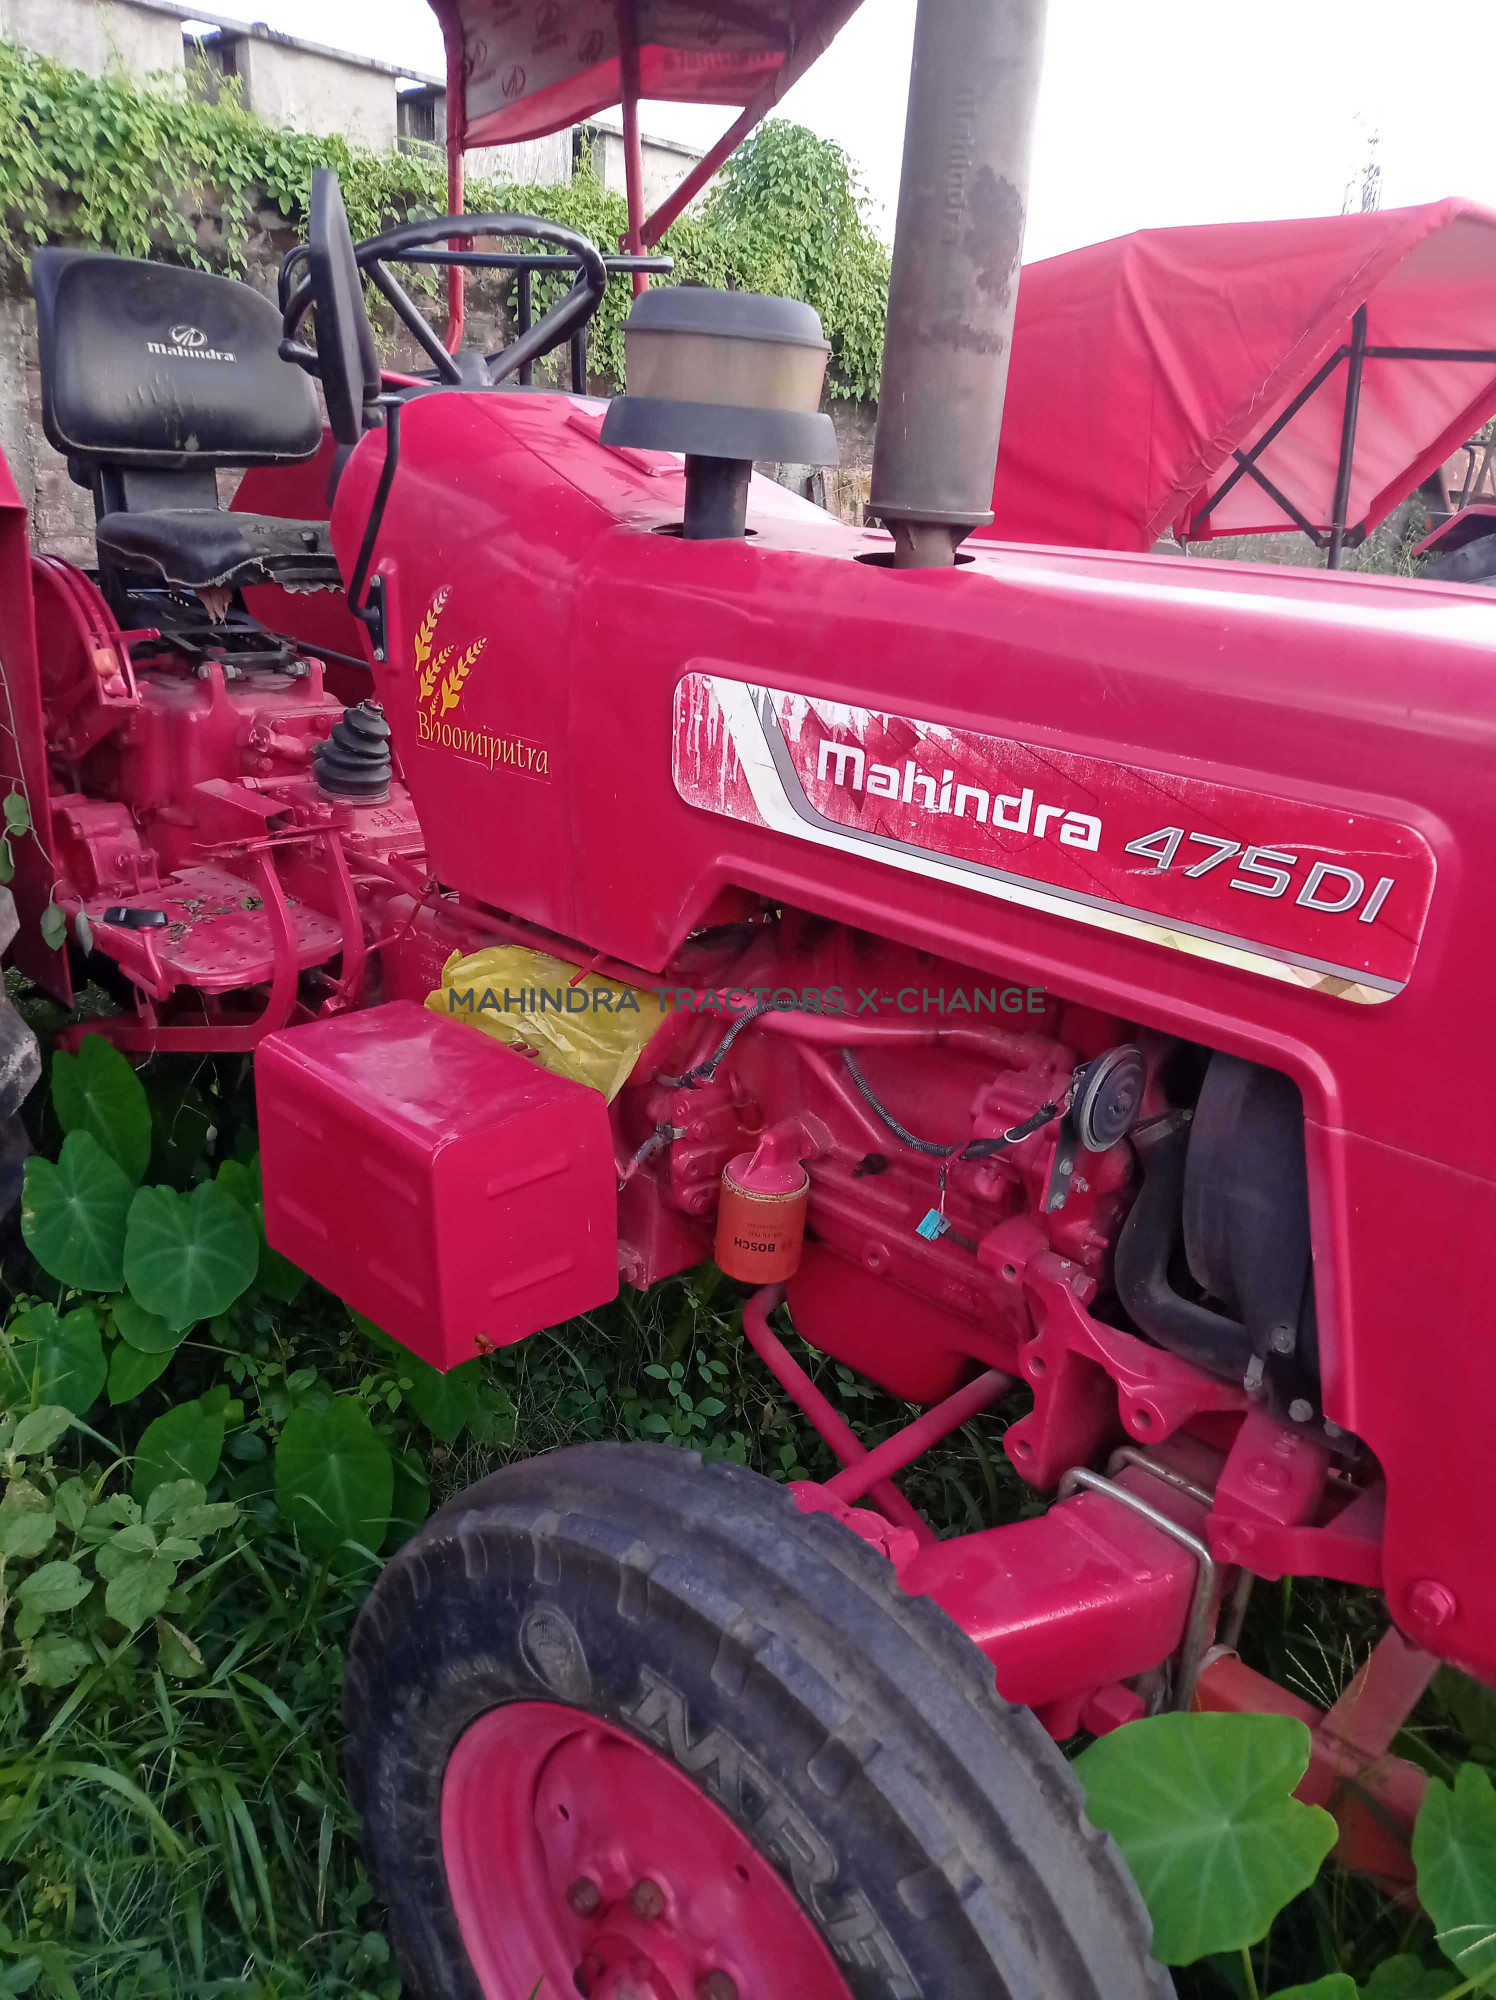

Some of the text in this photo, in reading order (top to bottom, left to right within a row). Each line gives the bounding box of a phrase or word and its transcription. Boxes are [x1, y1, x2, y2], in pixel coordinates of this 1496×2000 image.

[147, 341, 235, 362] mahindra
[417, 701, 549, 774] Bhoomiputra
[816, 739, 1395, 924] mahindra 475DI
[734, 1237, 776, 1252] BOSCH
